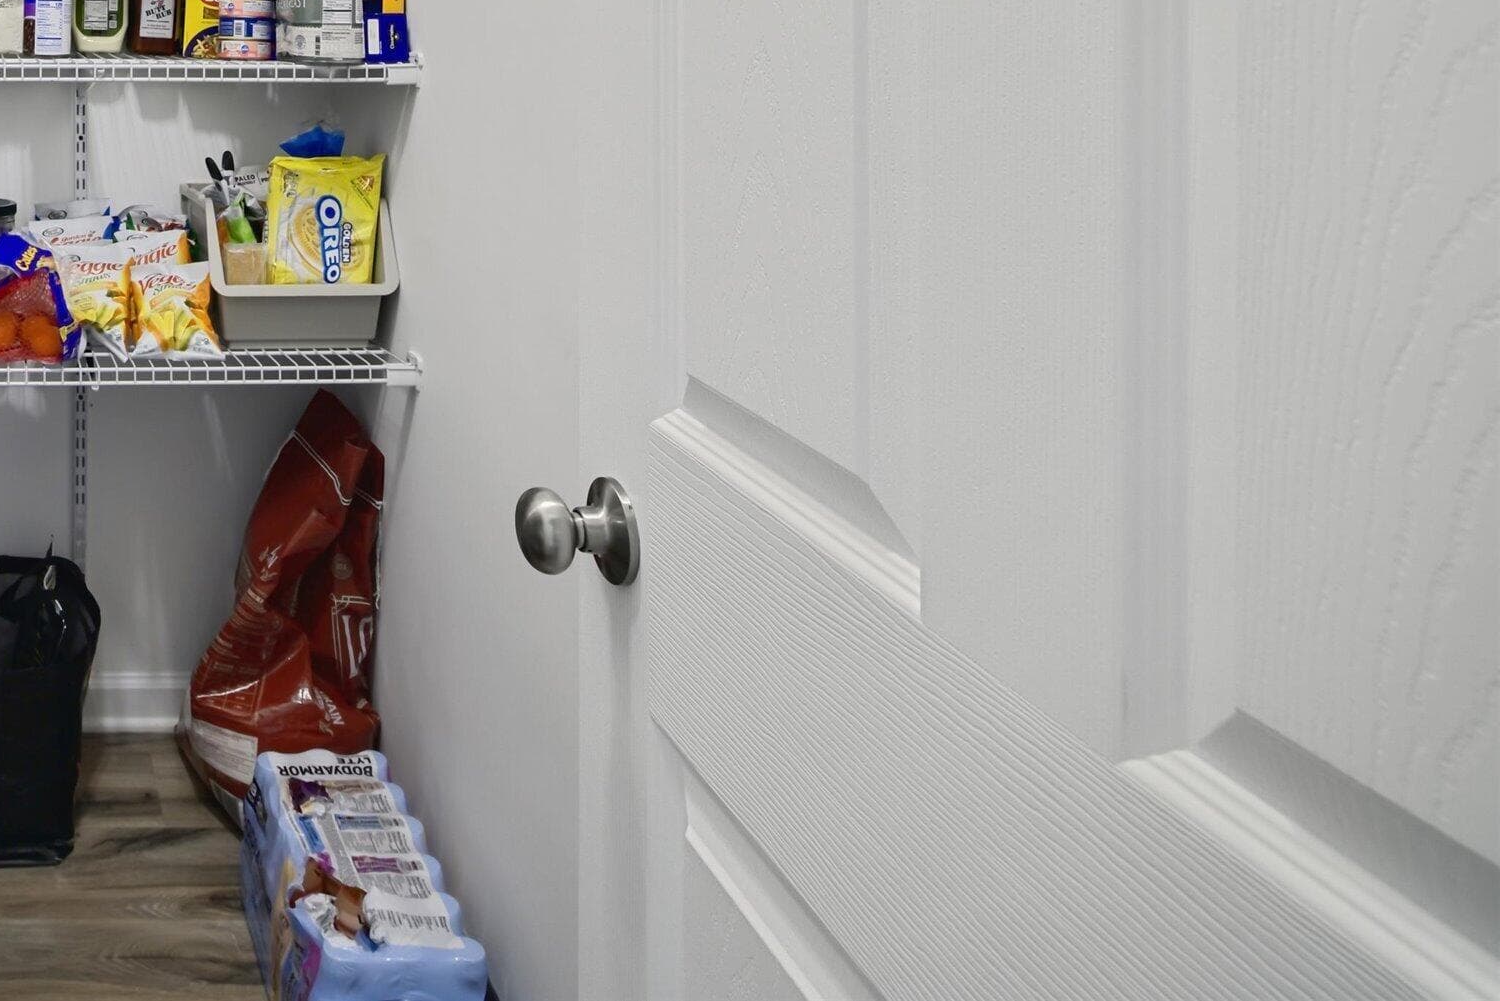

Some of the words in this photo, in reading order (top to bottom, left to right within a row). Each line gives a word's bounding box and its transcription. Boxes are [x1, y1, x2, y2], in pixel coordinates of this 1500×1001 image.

[145, 5, 166, 17] BUTT
[156, 9, 172, 20] RUB
[234, 174, 256, 182] PALEO
[318, 197, 341, 283] OREO
[342, 221, 353, 263] GOLDEN
[276, 765, 374, 777] BODYARMOR
